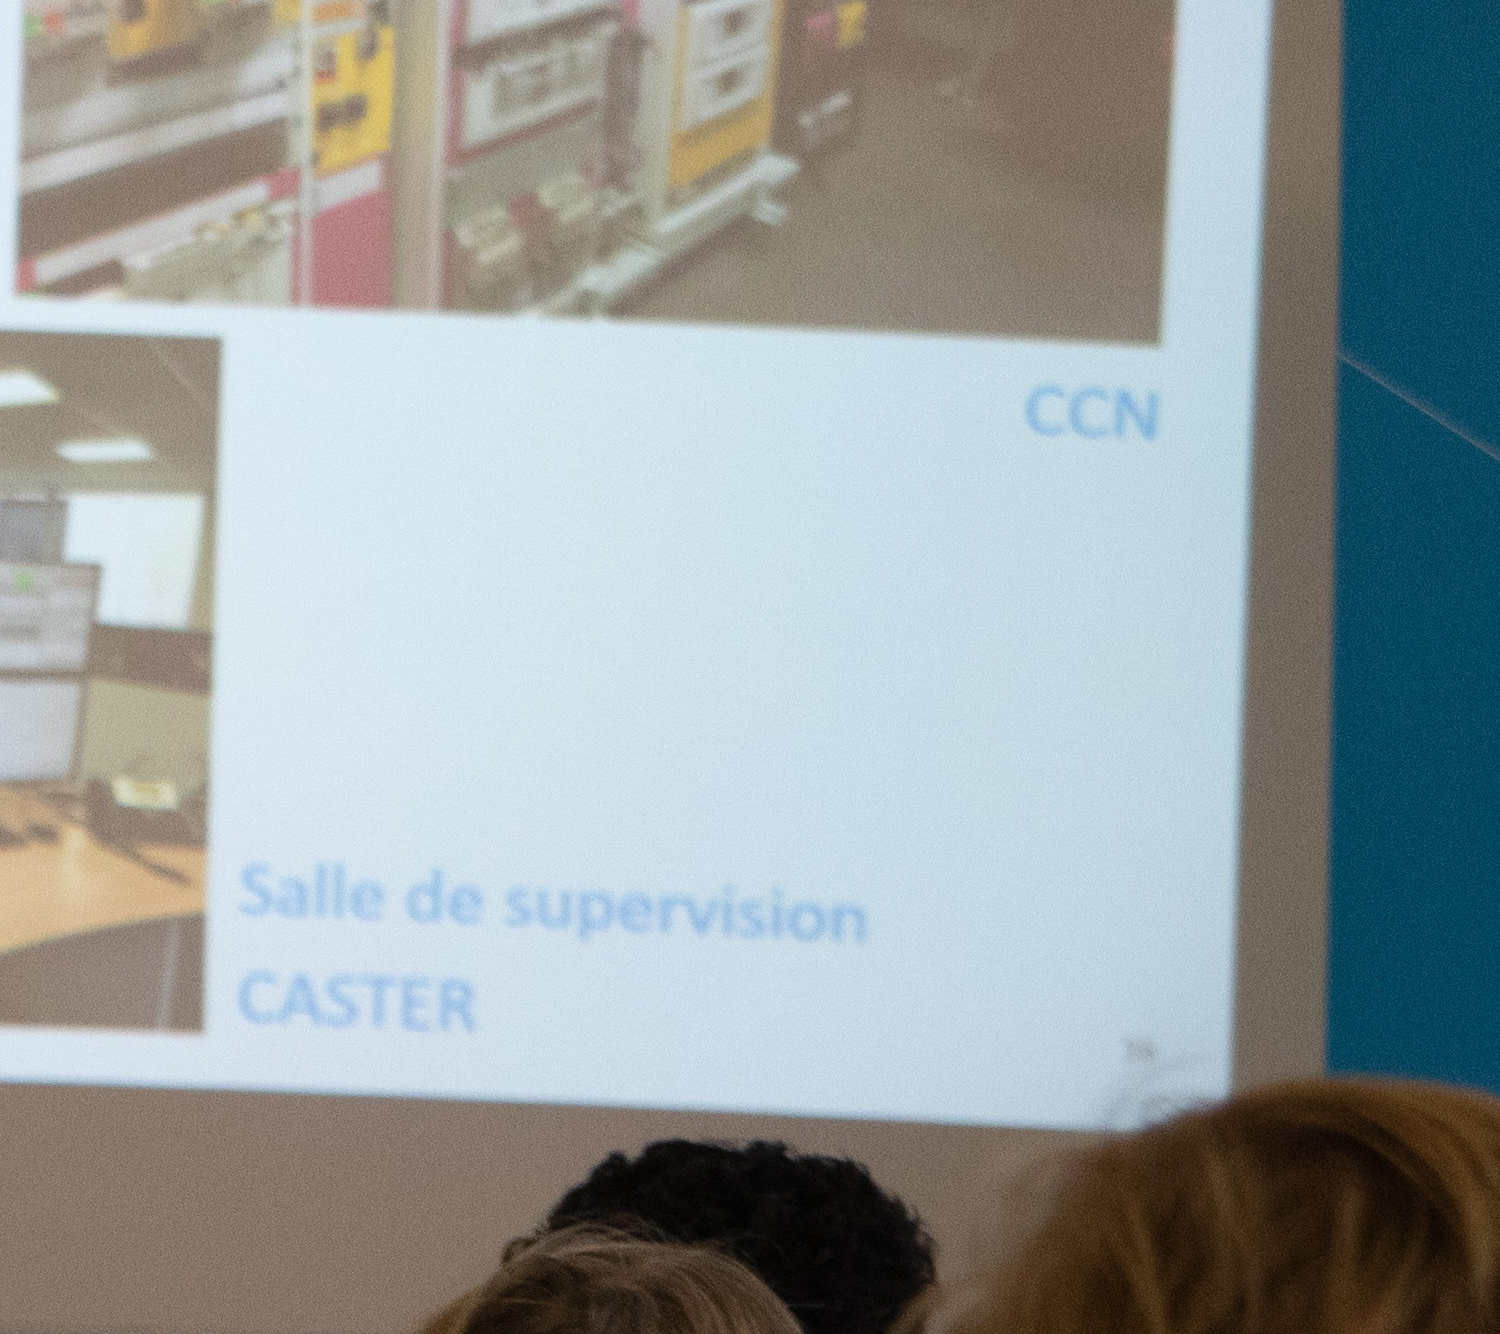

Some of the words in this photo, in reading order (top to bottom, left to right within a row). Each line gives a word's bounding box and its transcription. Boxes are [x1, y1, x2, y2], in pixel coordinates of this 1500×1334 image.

[1024, 383, 1161, 441] CCN
[239, 861, 384, 922] Salle
[406, 867, 484, 925] de
[504, 881, 869, 945] supervision
[237, 969, 478, 1034] CASTER
